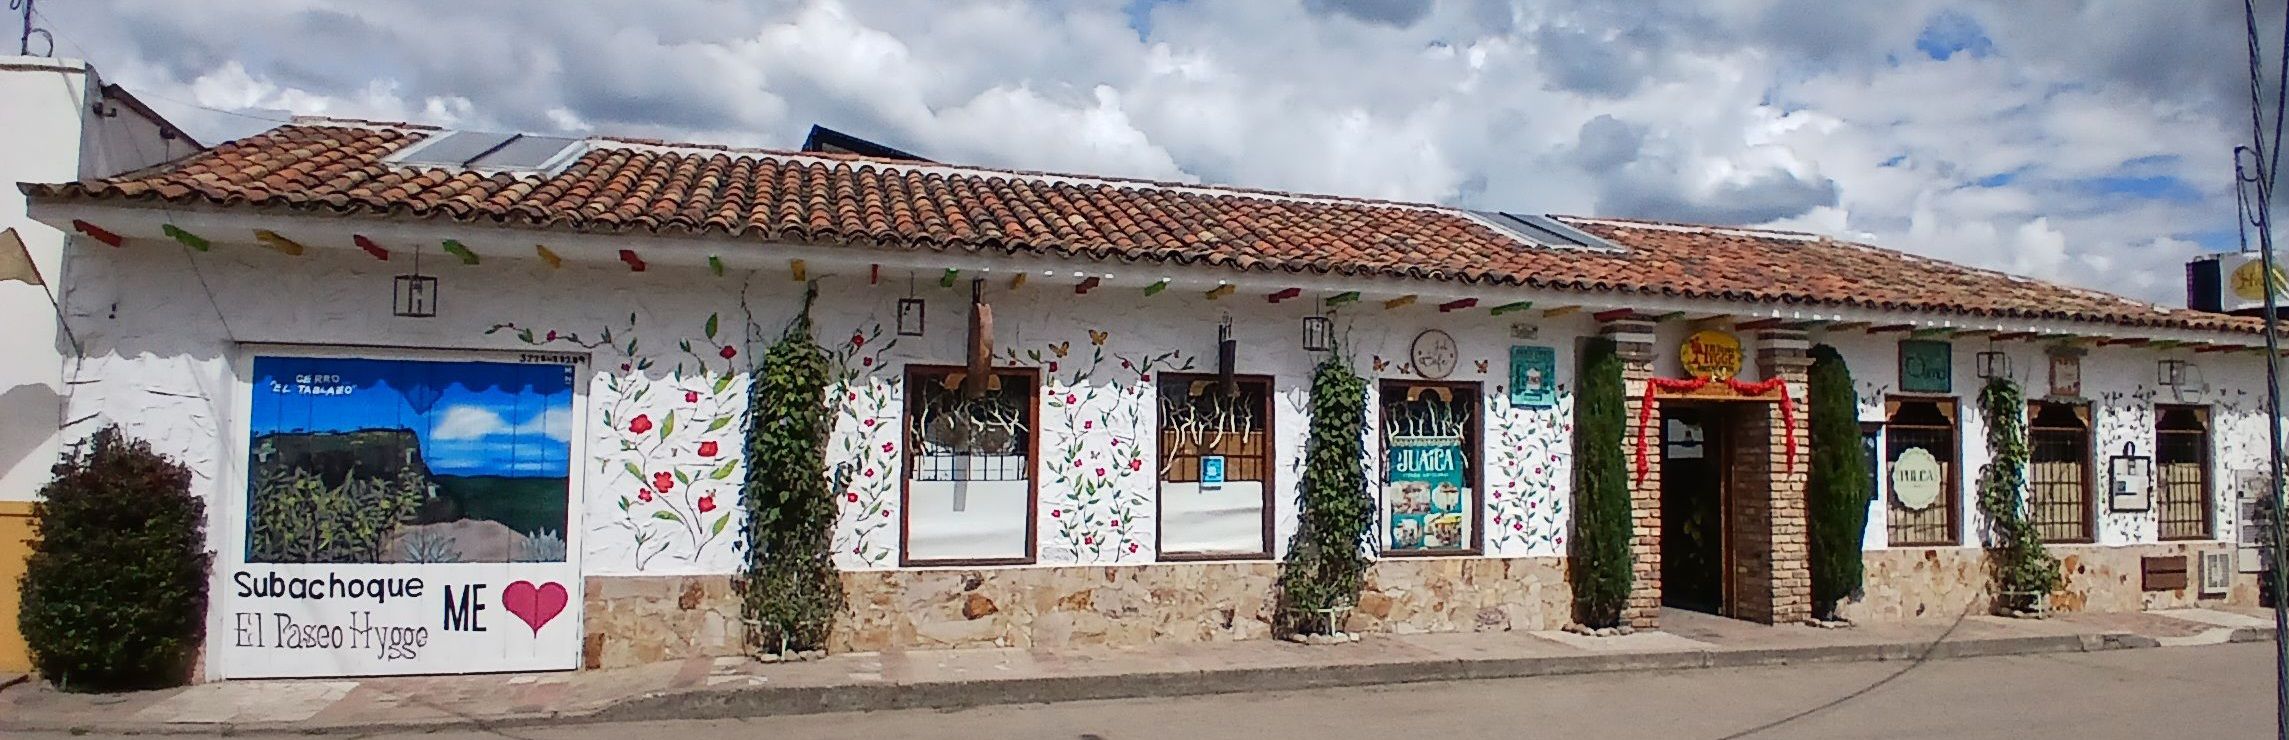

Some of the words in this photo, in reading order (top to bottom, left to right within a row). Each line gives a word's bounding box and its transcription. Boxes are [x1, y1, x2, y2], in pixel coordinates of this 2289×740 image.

[295, 374, 340, 384] CERRO
[233, 570, 424, 604] Subachoque
[443, 583, 487, 632] ME
[233, 611, 266, 648] El
[273, 612, 344, 649] Paseo
[349, 610, 429, 662] Hygge
